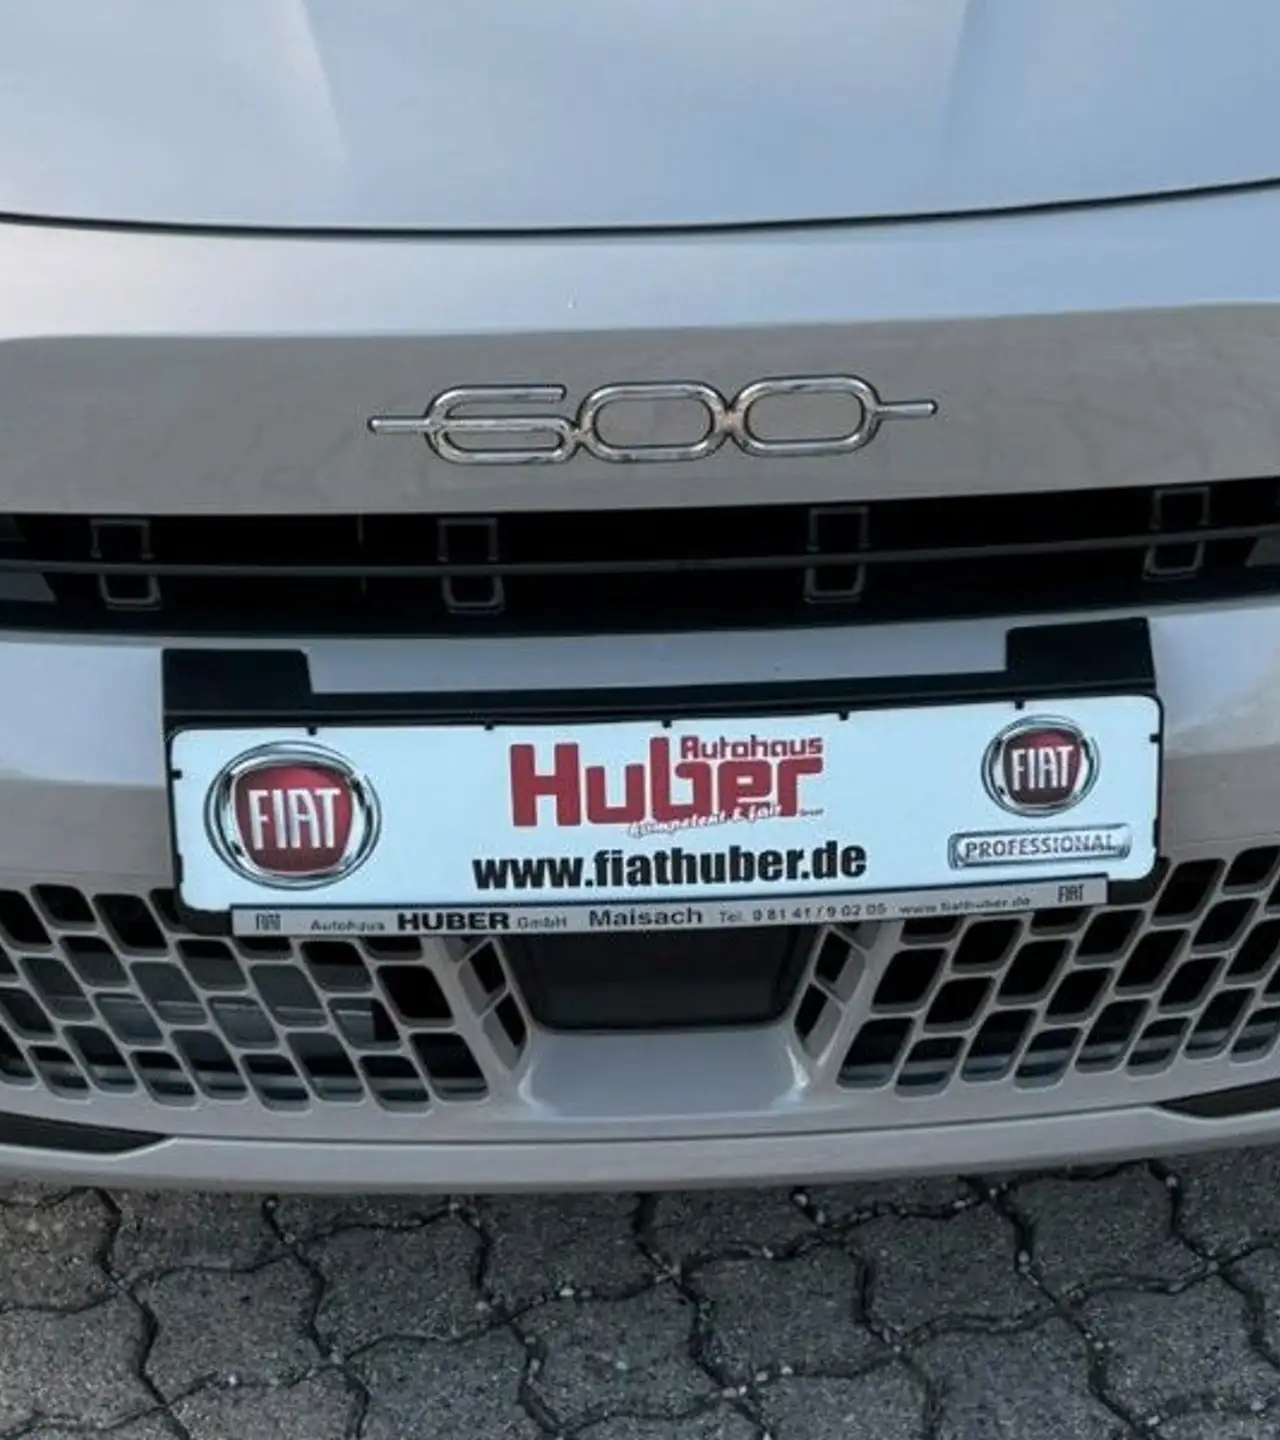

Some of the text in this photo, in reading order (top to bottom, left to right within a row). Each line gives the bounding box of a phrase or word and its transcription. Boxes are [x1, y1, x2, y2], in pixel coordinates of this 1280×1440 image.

[368, 374, 938, 464] 600
[680, 734, 824, 760] Autohaus
[1011, 745, 1075, 791] FIAT
[509, 736, 824, 827] Huber
[248, 787, 341, 850] FIAT
[472, 840, 868, 890] www.fiathuber.de
[964, 833, 1117, 860] PROFESSIONAL
[1057, 884, 1085, 903] FIAT
[397, 911, 510, 931] HUBER
[517, 915, 568, 930] GmbH
[588, 906, 703, 929] Maisach
